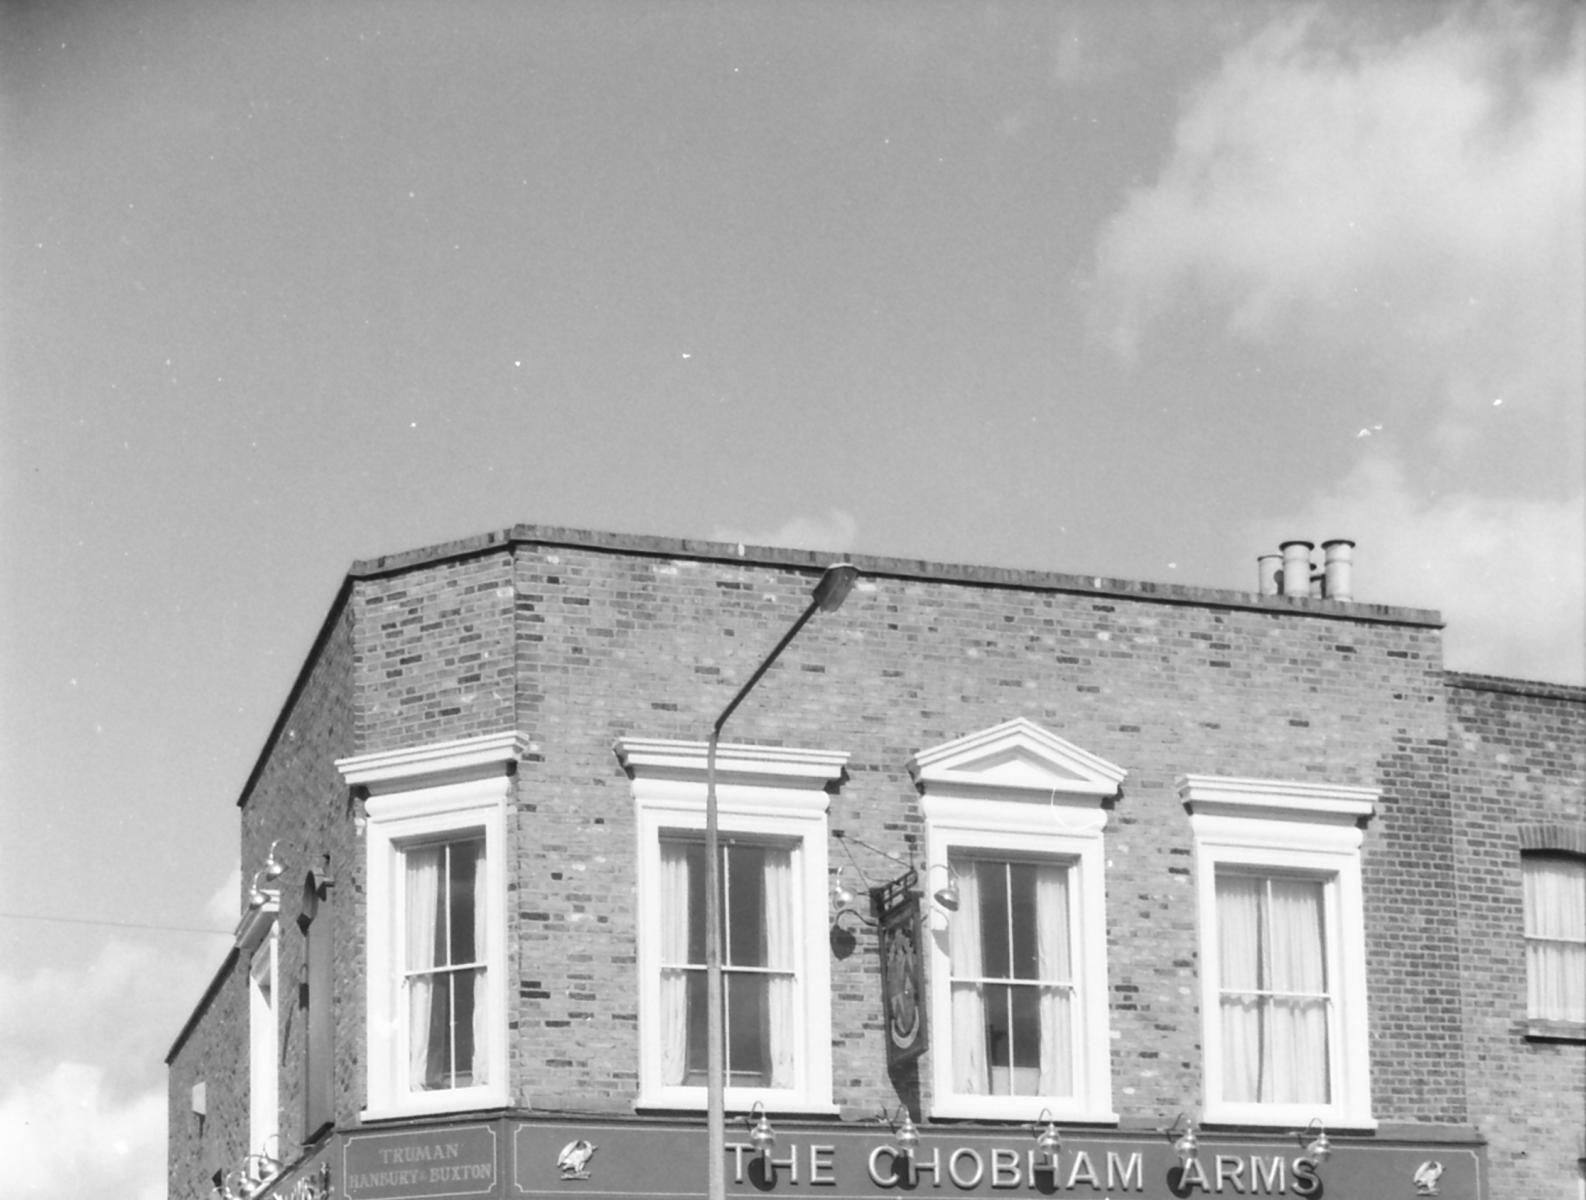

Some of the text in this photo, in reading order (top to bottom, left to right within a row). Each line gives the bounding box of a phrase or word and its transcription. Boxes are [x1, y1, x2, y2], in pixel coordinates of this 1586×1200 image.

[379, 1143, 459, 1164] TRUMAN
[349, 1168, 418, 1188] HANBURY
[430, 1163, 492, 1183] BUXTON
[724, 1142, 1322, 1197] THE CHOBHAM ARMS
